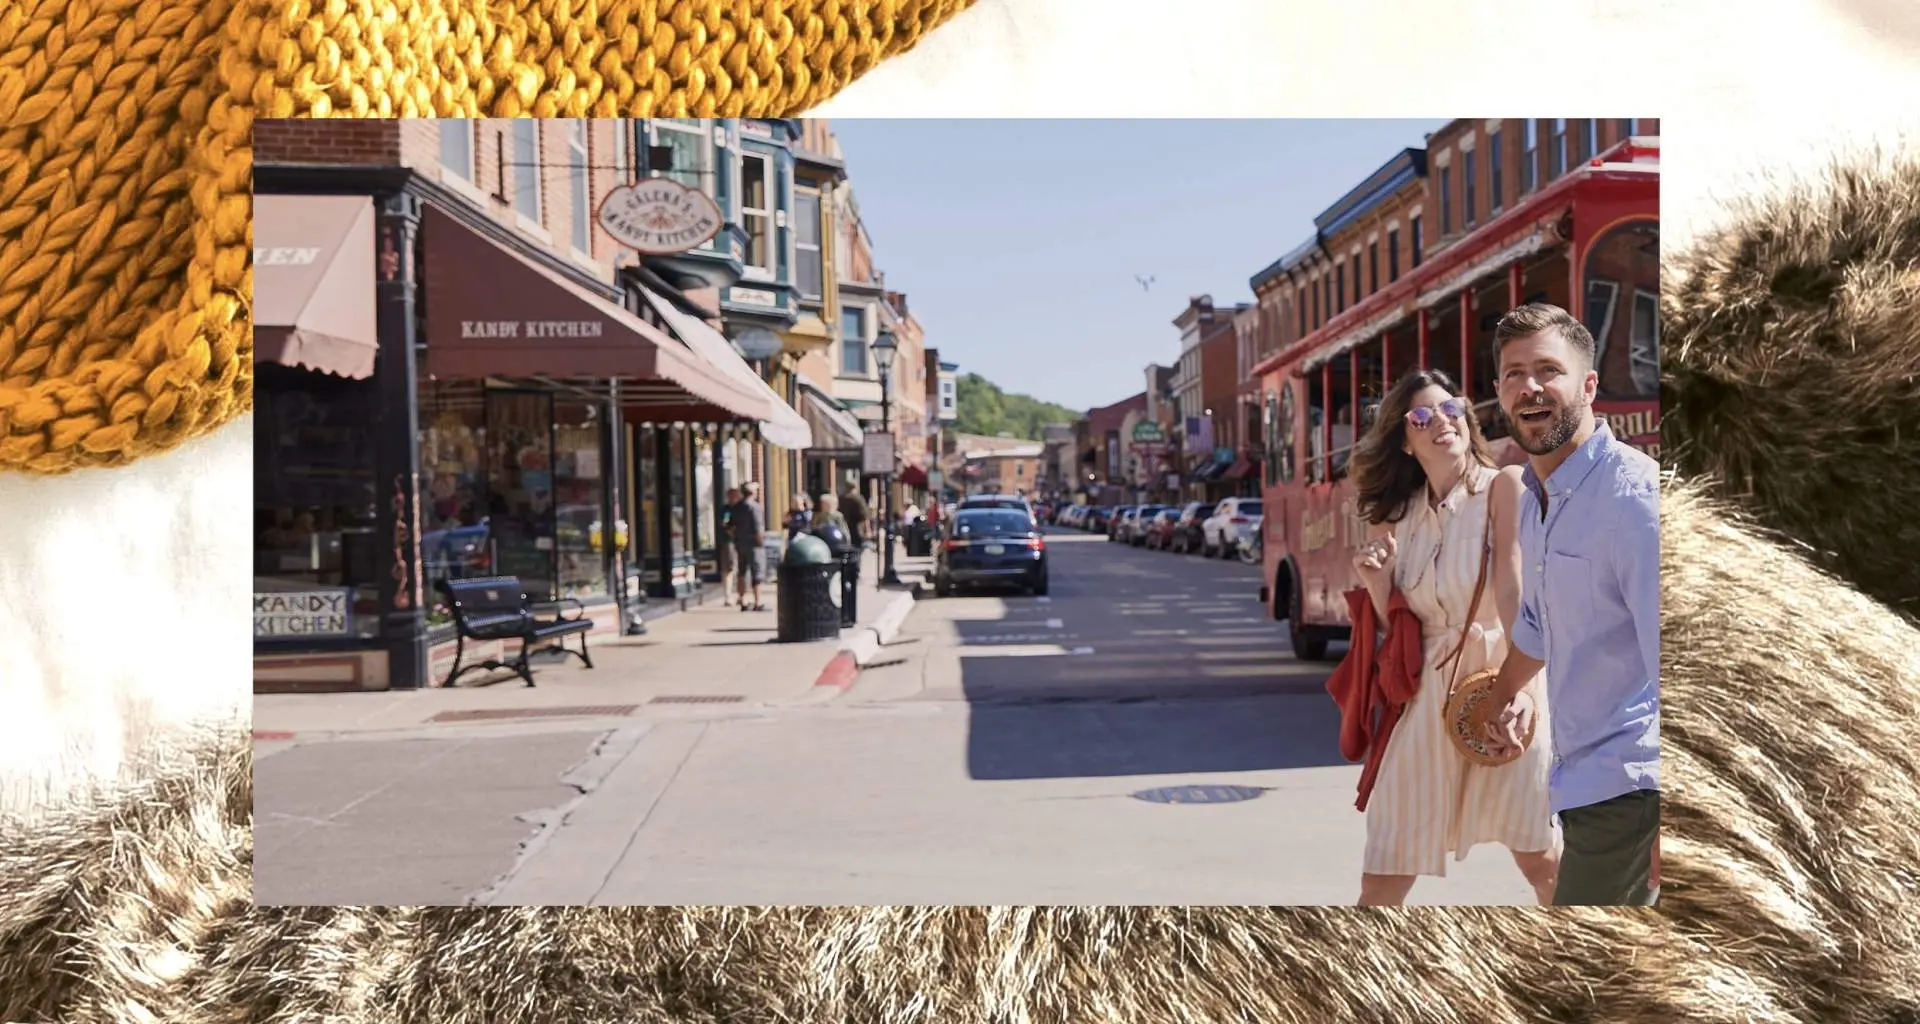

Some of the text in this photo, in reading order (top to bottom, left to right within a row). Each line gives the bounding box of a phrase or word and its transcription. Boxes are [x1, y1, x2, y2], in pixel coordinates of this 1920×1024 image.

[607, 213, 713, 245] KANDY KITCHEN
[461, 321, 602, 338] KANDY KITCHEN
[253, 595, 343, 612] KANDY
